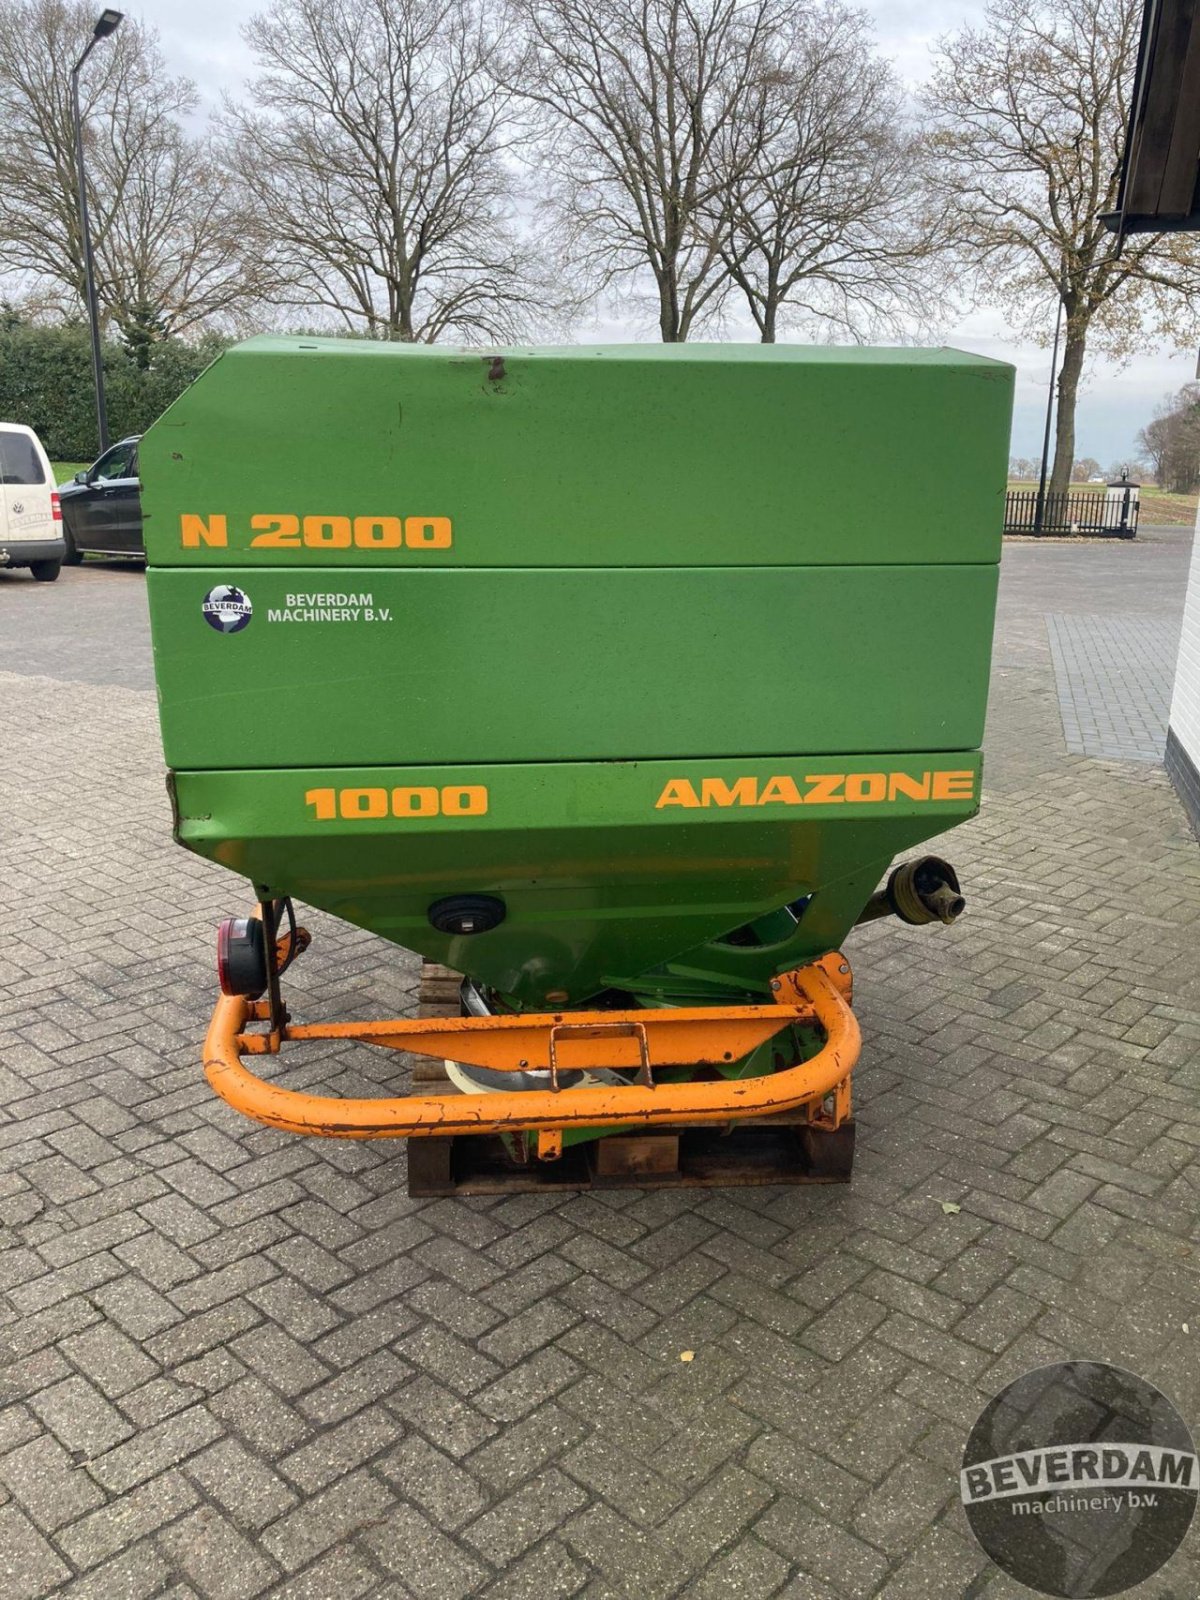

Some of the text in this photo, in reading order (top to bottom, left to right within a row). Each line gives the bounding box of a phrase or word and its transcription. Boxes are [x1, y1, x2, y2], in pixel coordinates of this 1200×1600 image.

[181, 514, 453, 549] N 2000
[203, 602, 253, 614] BEVERDAM
[286, 593, 374, 607] BEVERDAM
[267, 608, 394, 622] MACHINERY B.V.
[654, 770, 975, 809] AMAZONE
[305, 785, 489, 820] 1000
